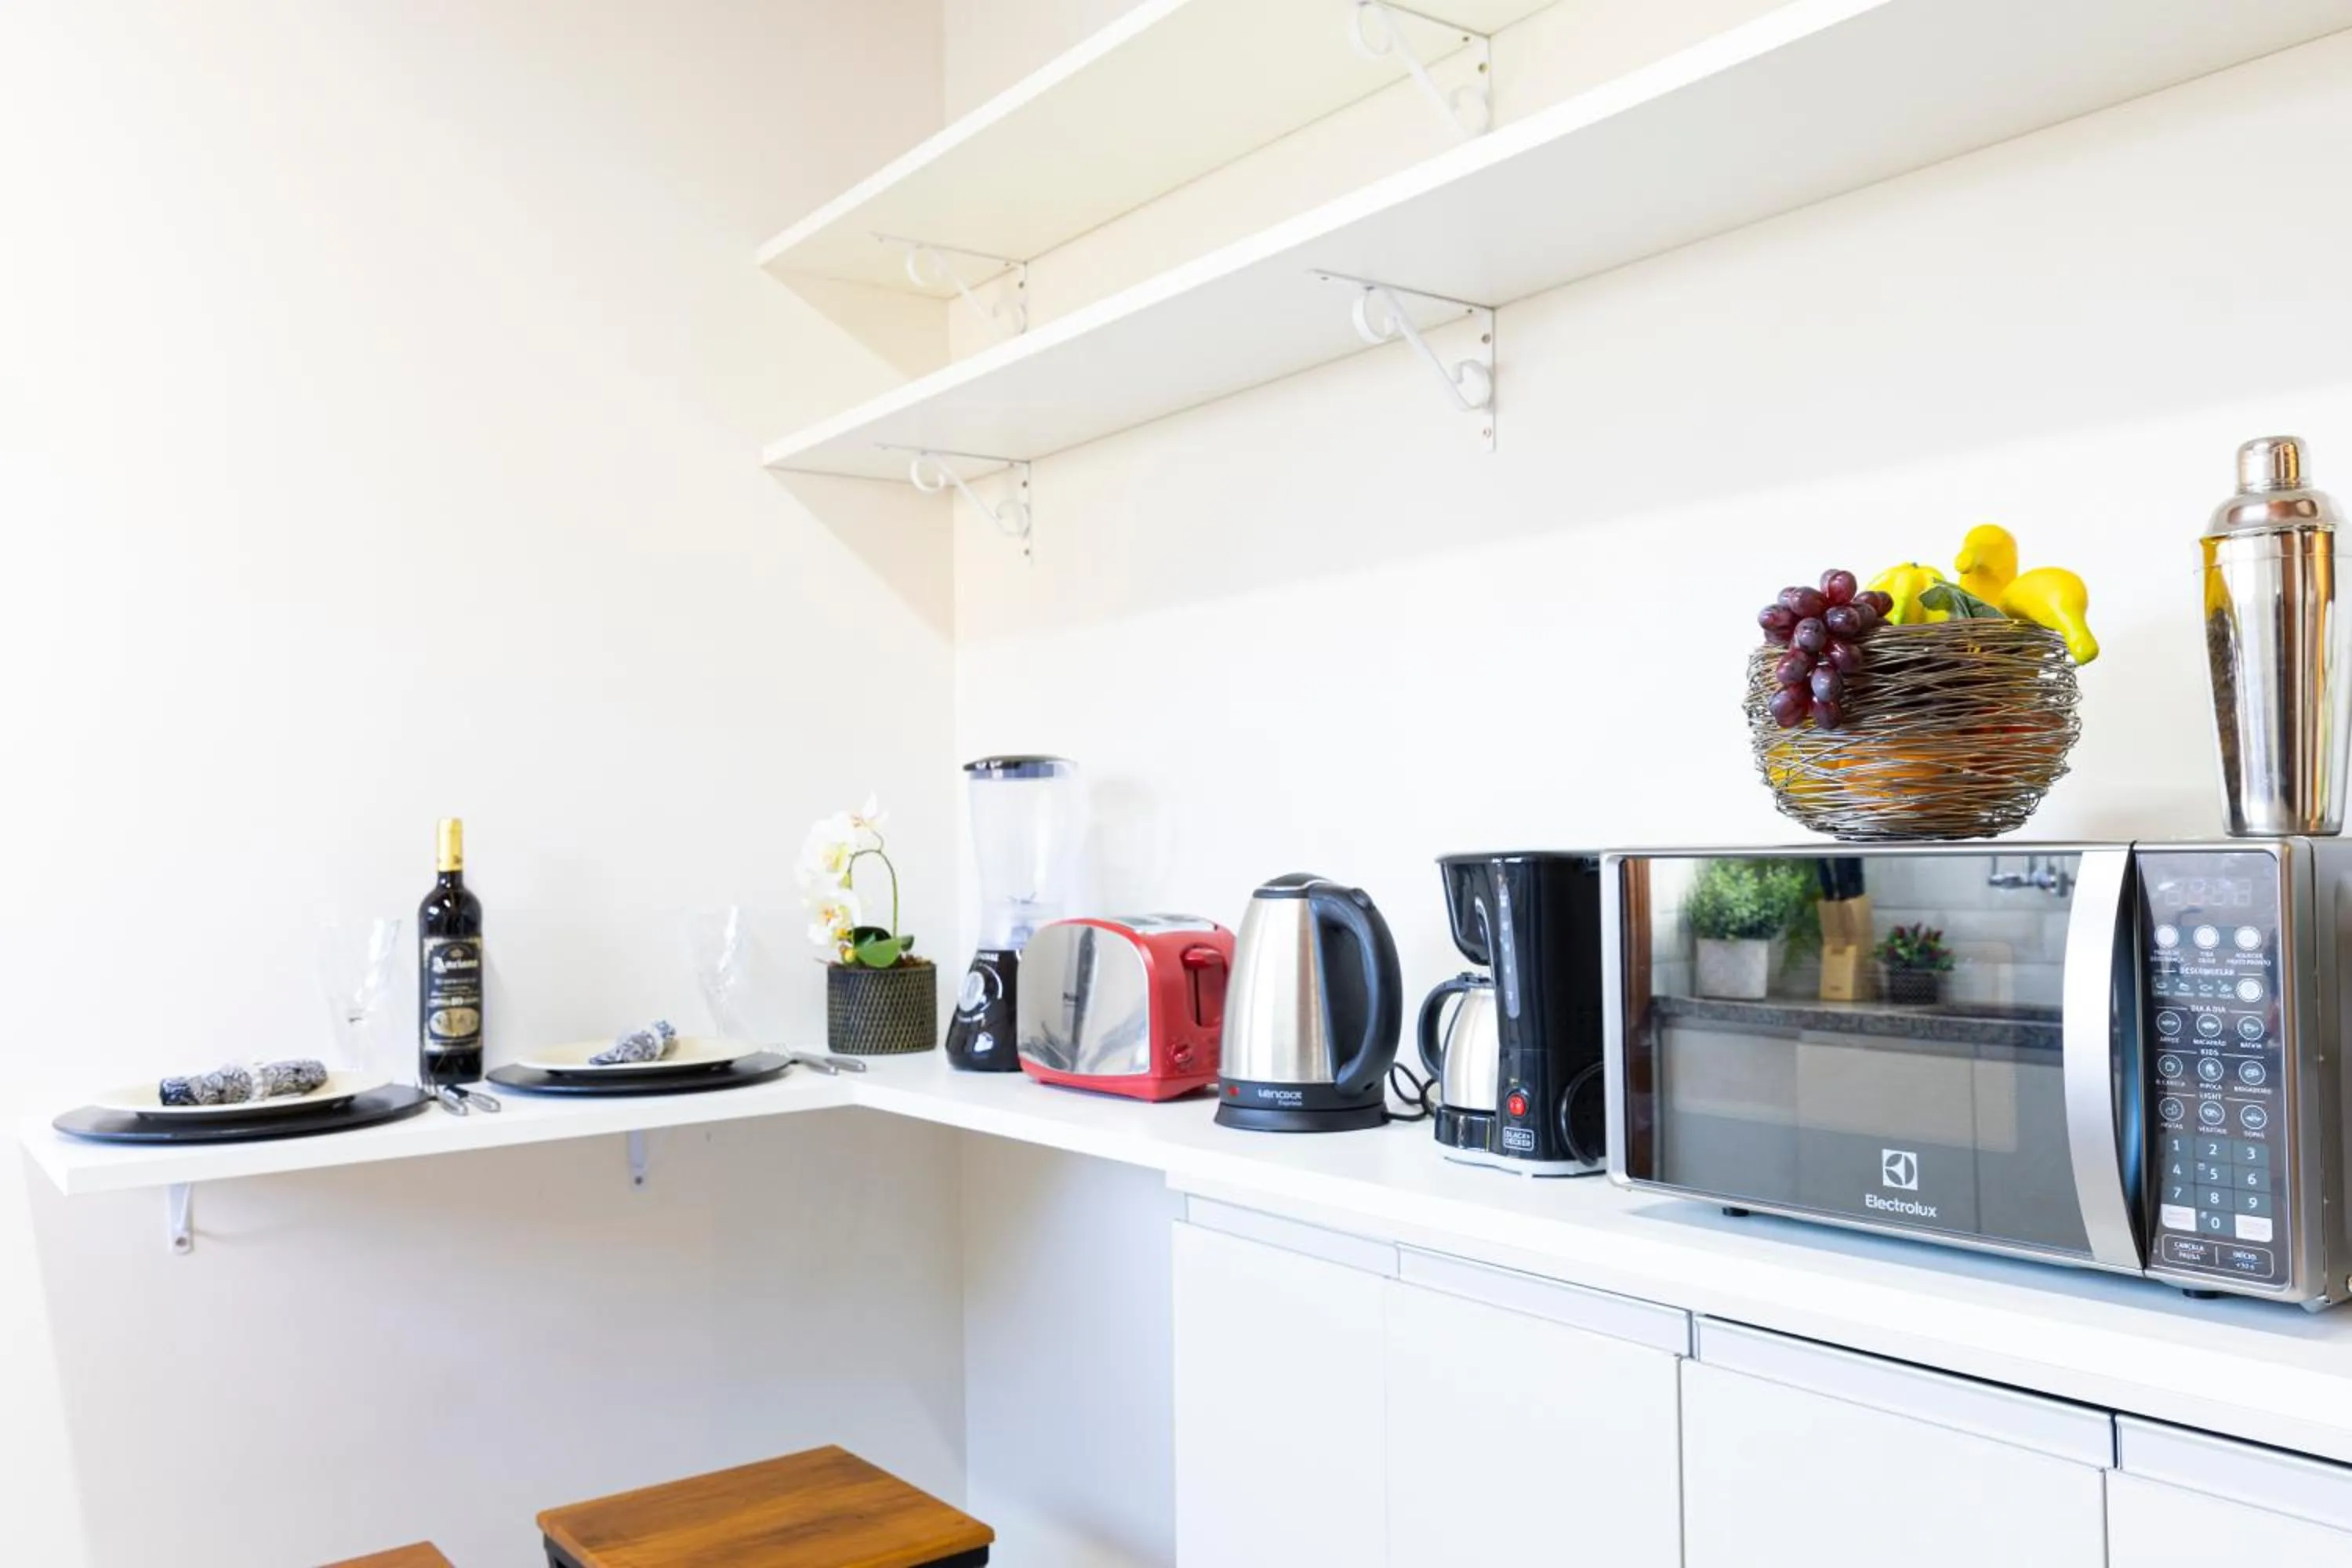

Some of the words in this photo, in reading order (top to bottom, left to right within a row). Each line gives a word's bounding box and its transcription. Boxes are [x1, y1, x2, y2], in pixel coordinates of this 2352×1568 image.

[2172, 1139, 2180, 1152] 1
[2209, 1143, 2218, 1156] 2
[2246, 1147, 2256, 1160] 3
[2172, 1163, 2182, 1175] 4
[2210, 1168, 2219, 1180] 5
[2247, 1173, 2257, 1185] 6
[1865, 1193, 1936, 1217] Electrolux
[2173, 1187, 2182, 1199] 7
[2210, 1192, 2220, 1204] 8
[2248, 1197, 2258, 1209] 9
[2211, 1217, 2220, 1229] 0
